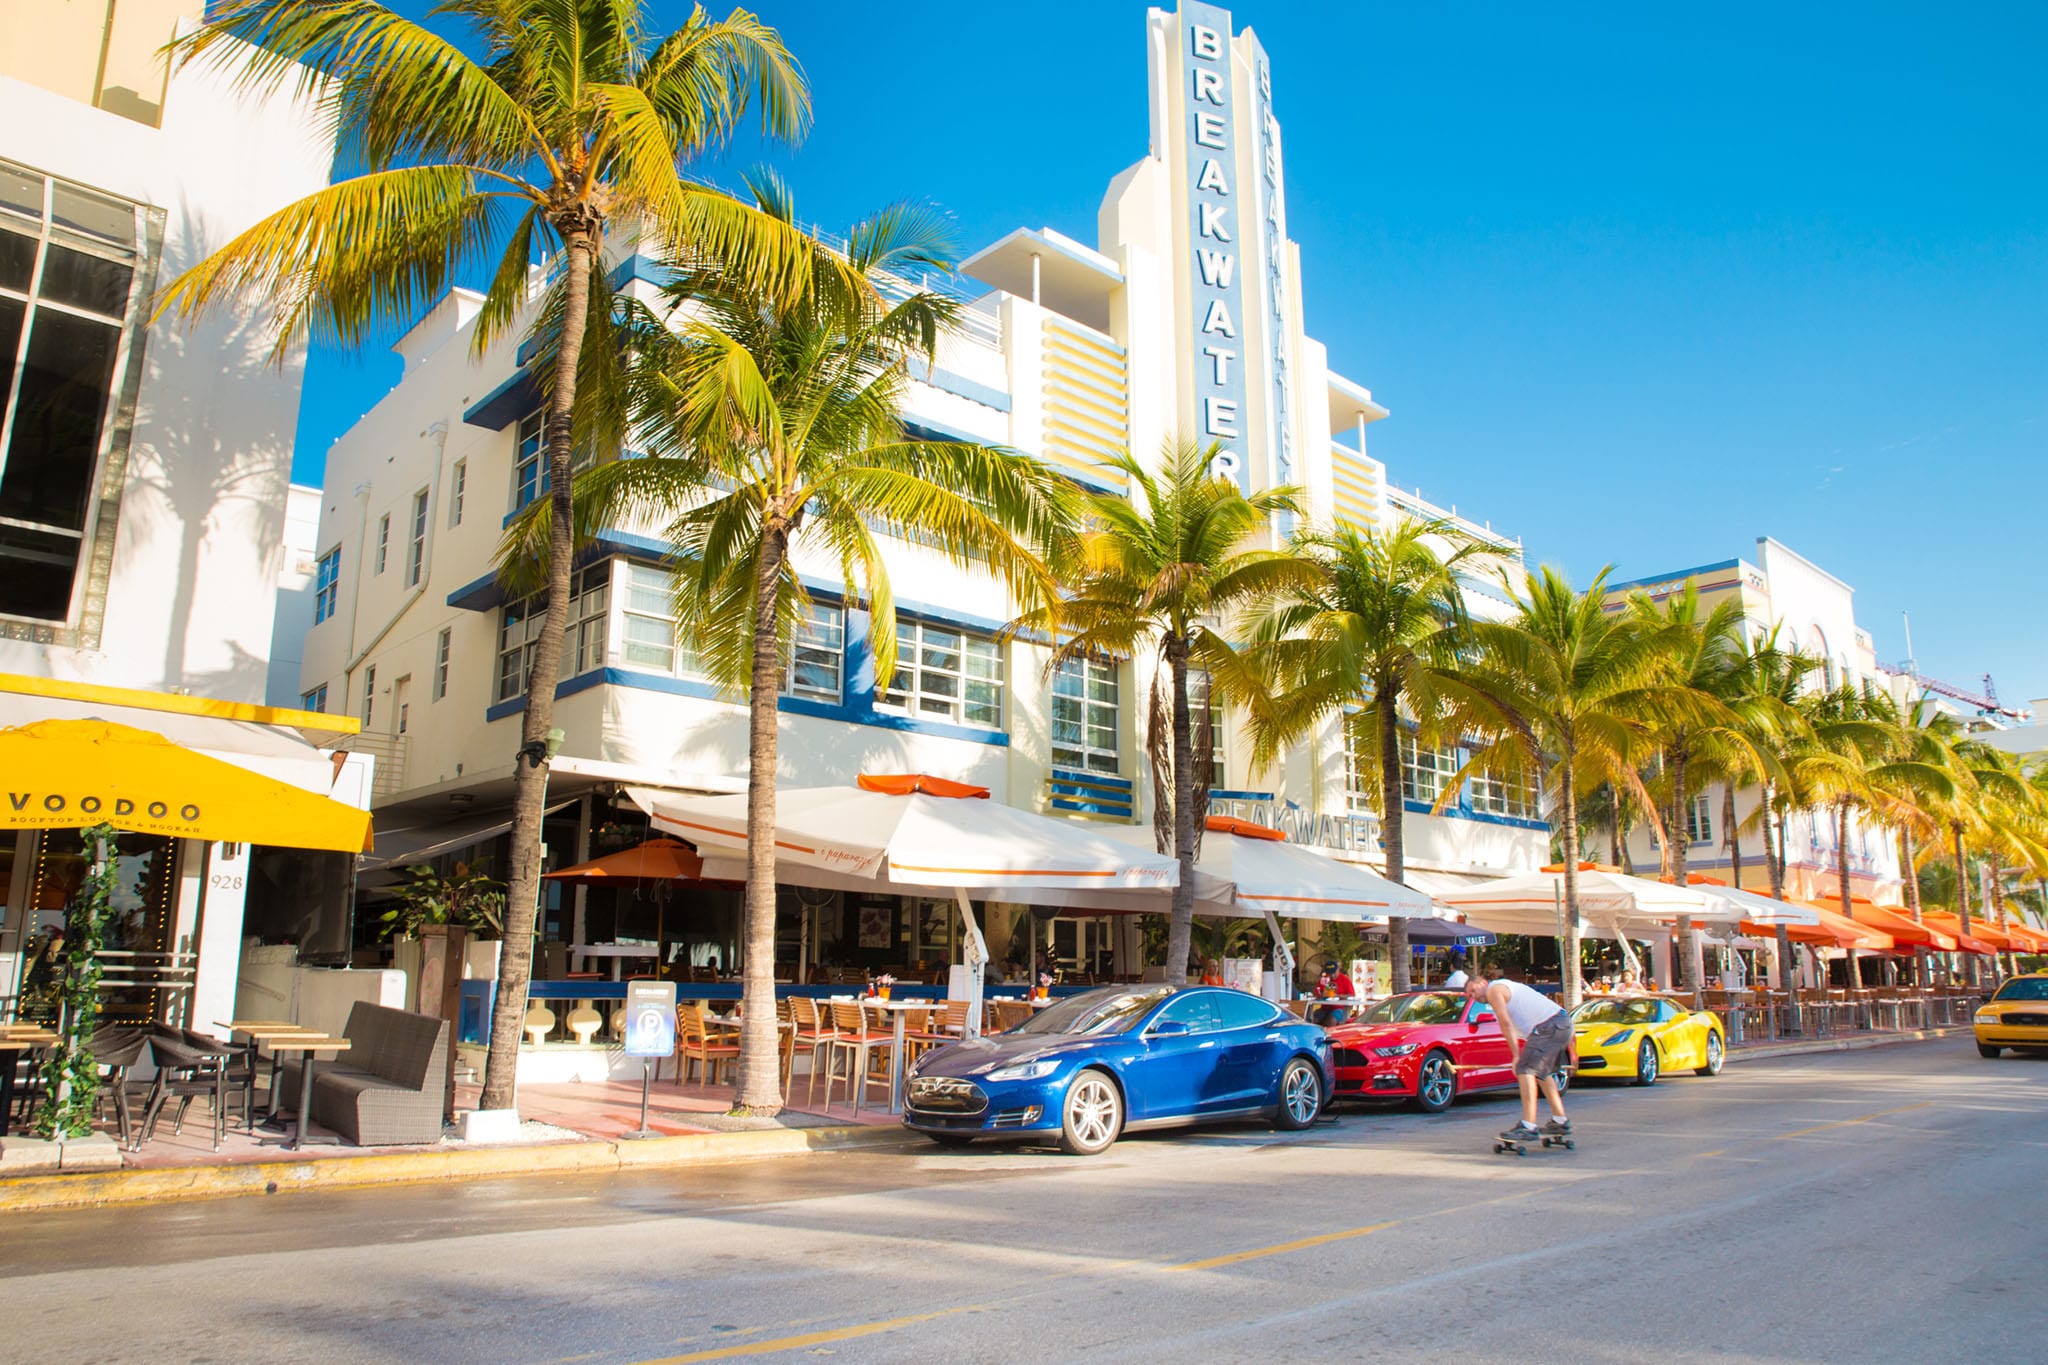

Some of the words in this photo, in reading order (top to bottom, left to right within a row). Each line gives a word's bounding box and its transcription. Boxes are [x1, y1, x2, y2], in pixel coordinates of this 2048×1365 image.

[1190, 23, 1241, 488] BREAKWATER
[1258, 59, 1291, 486] BREAKWATE
[9, 792, 200, 821] VOODOO
[212, 874, 242, 890] 928
[1465, 935, 1486, 945] VALET
